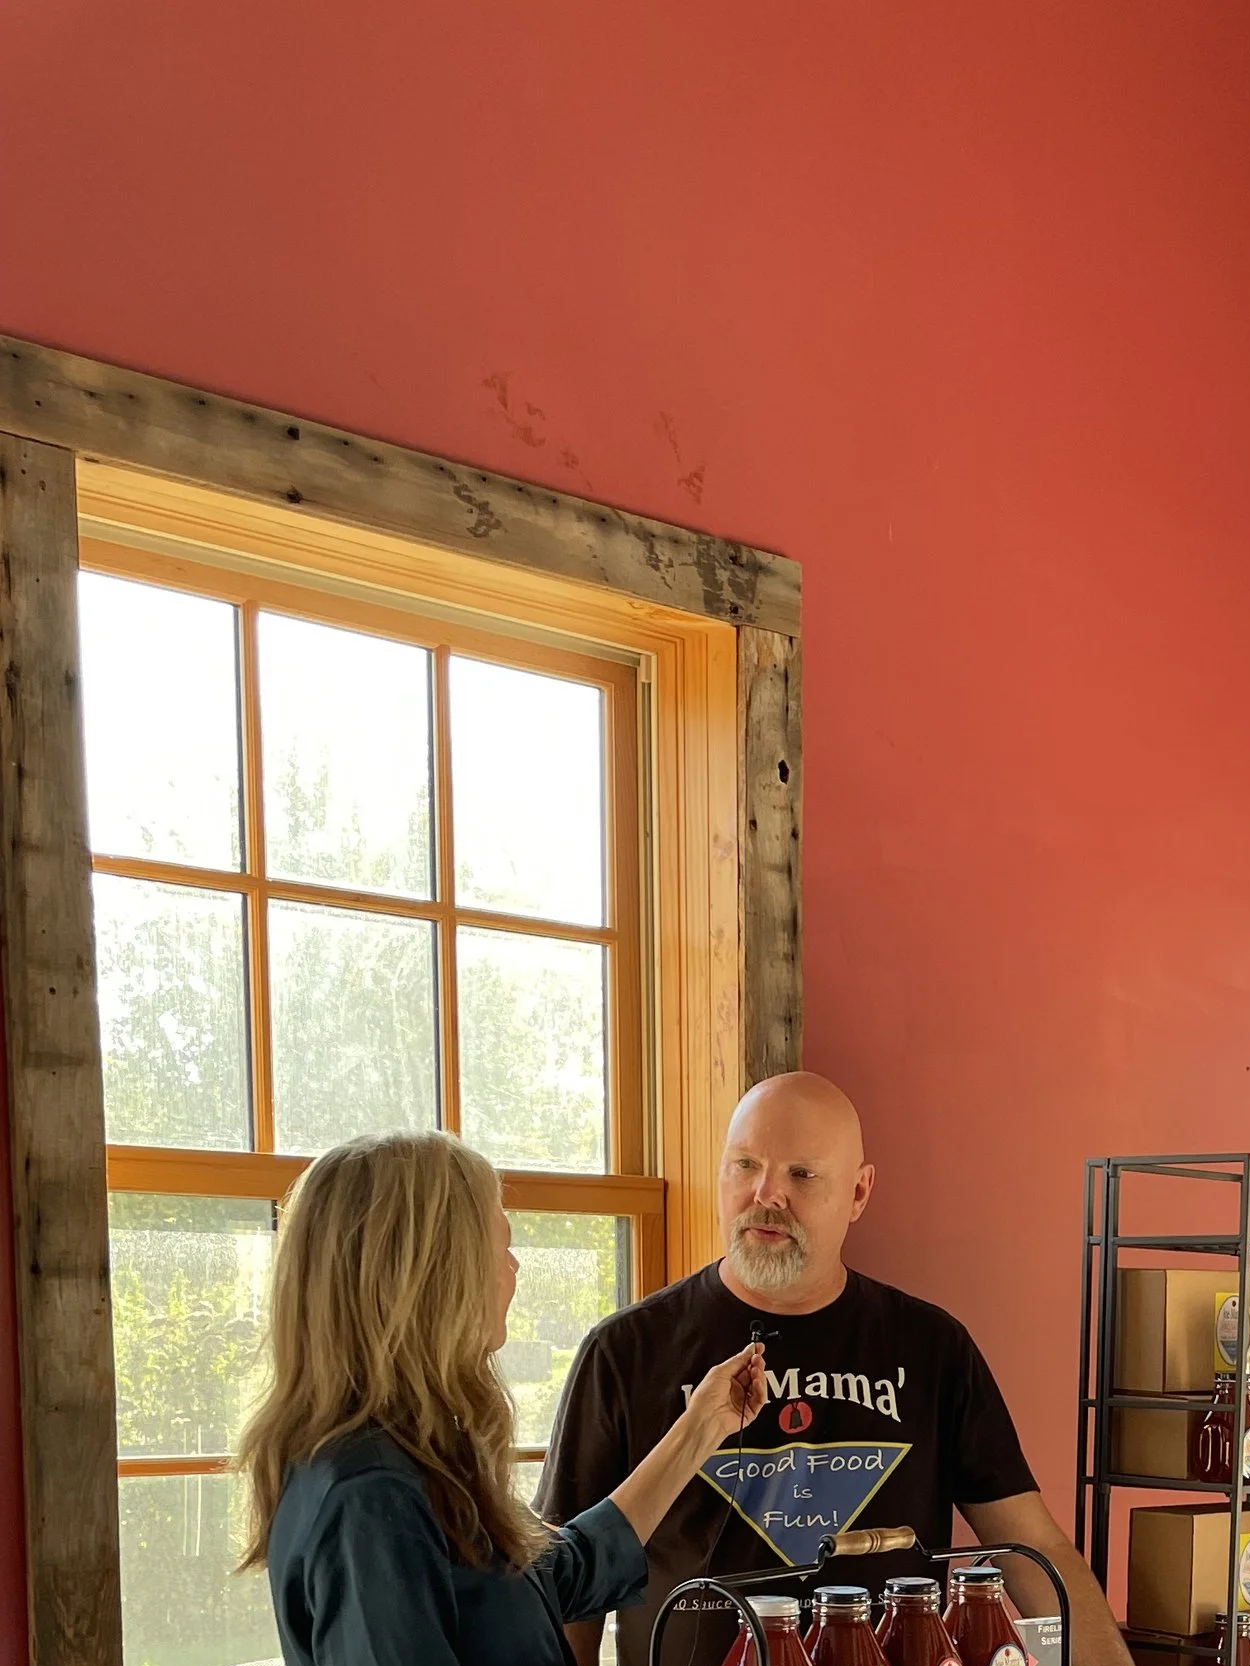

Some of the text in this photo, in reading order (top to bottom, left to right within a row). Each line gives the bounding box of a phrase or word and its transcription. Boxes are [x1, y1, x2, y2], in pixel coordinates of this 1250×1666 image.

[716, 1450, 884, 1482] Good Food
[793, 1484, 813, 1499] is
[763, 1510, 839, 1528] Fun!
[1041, 1636, 1061, 1645] SERIE
